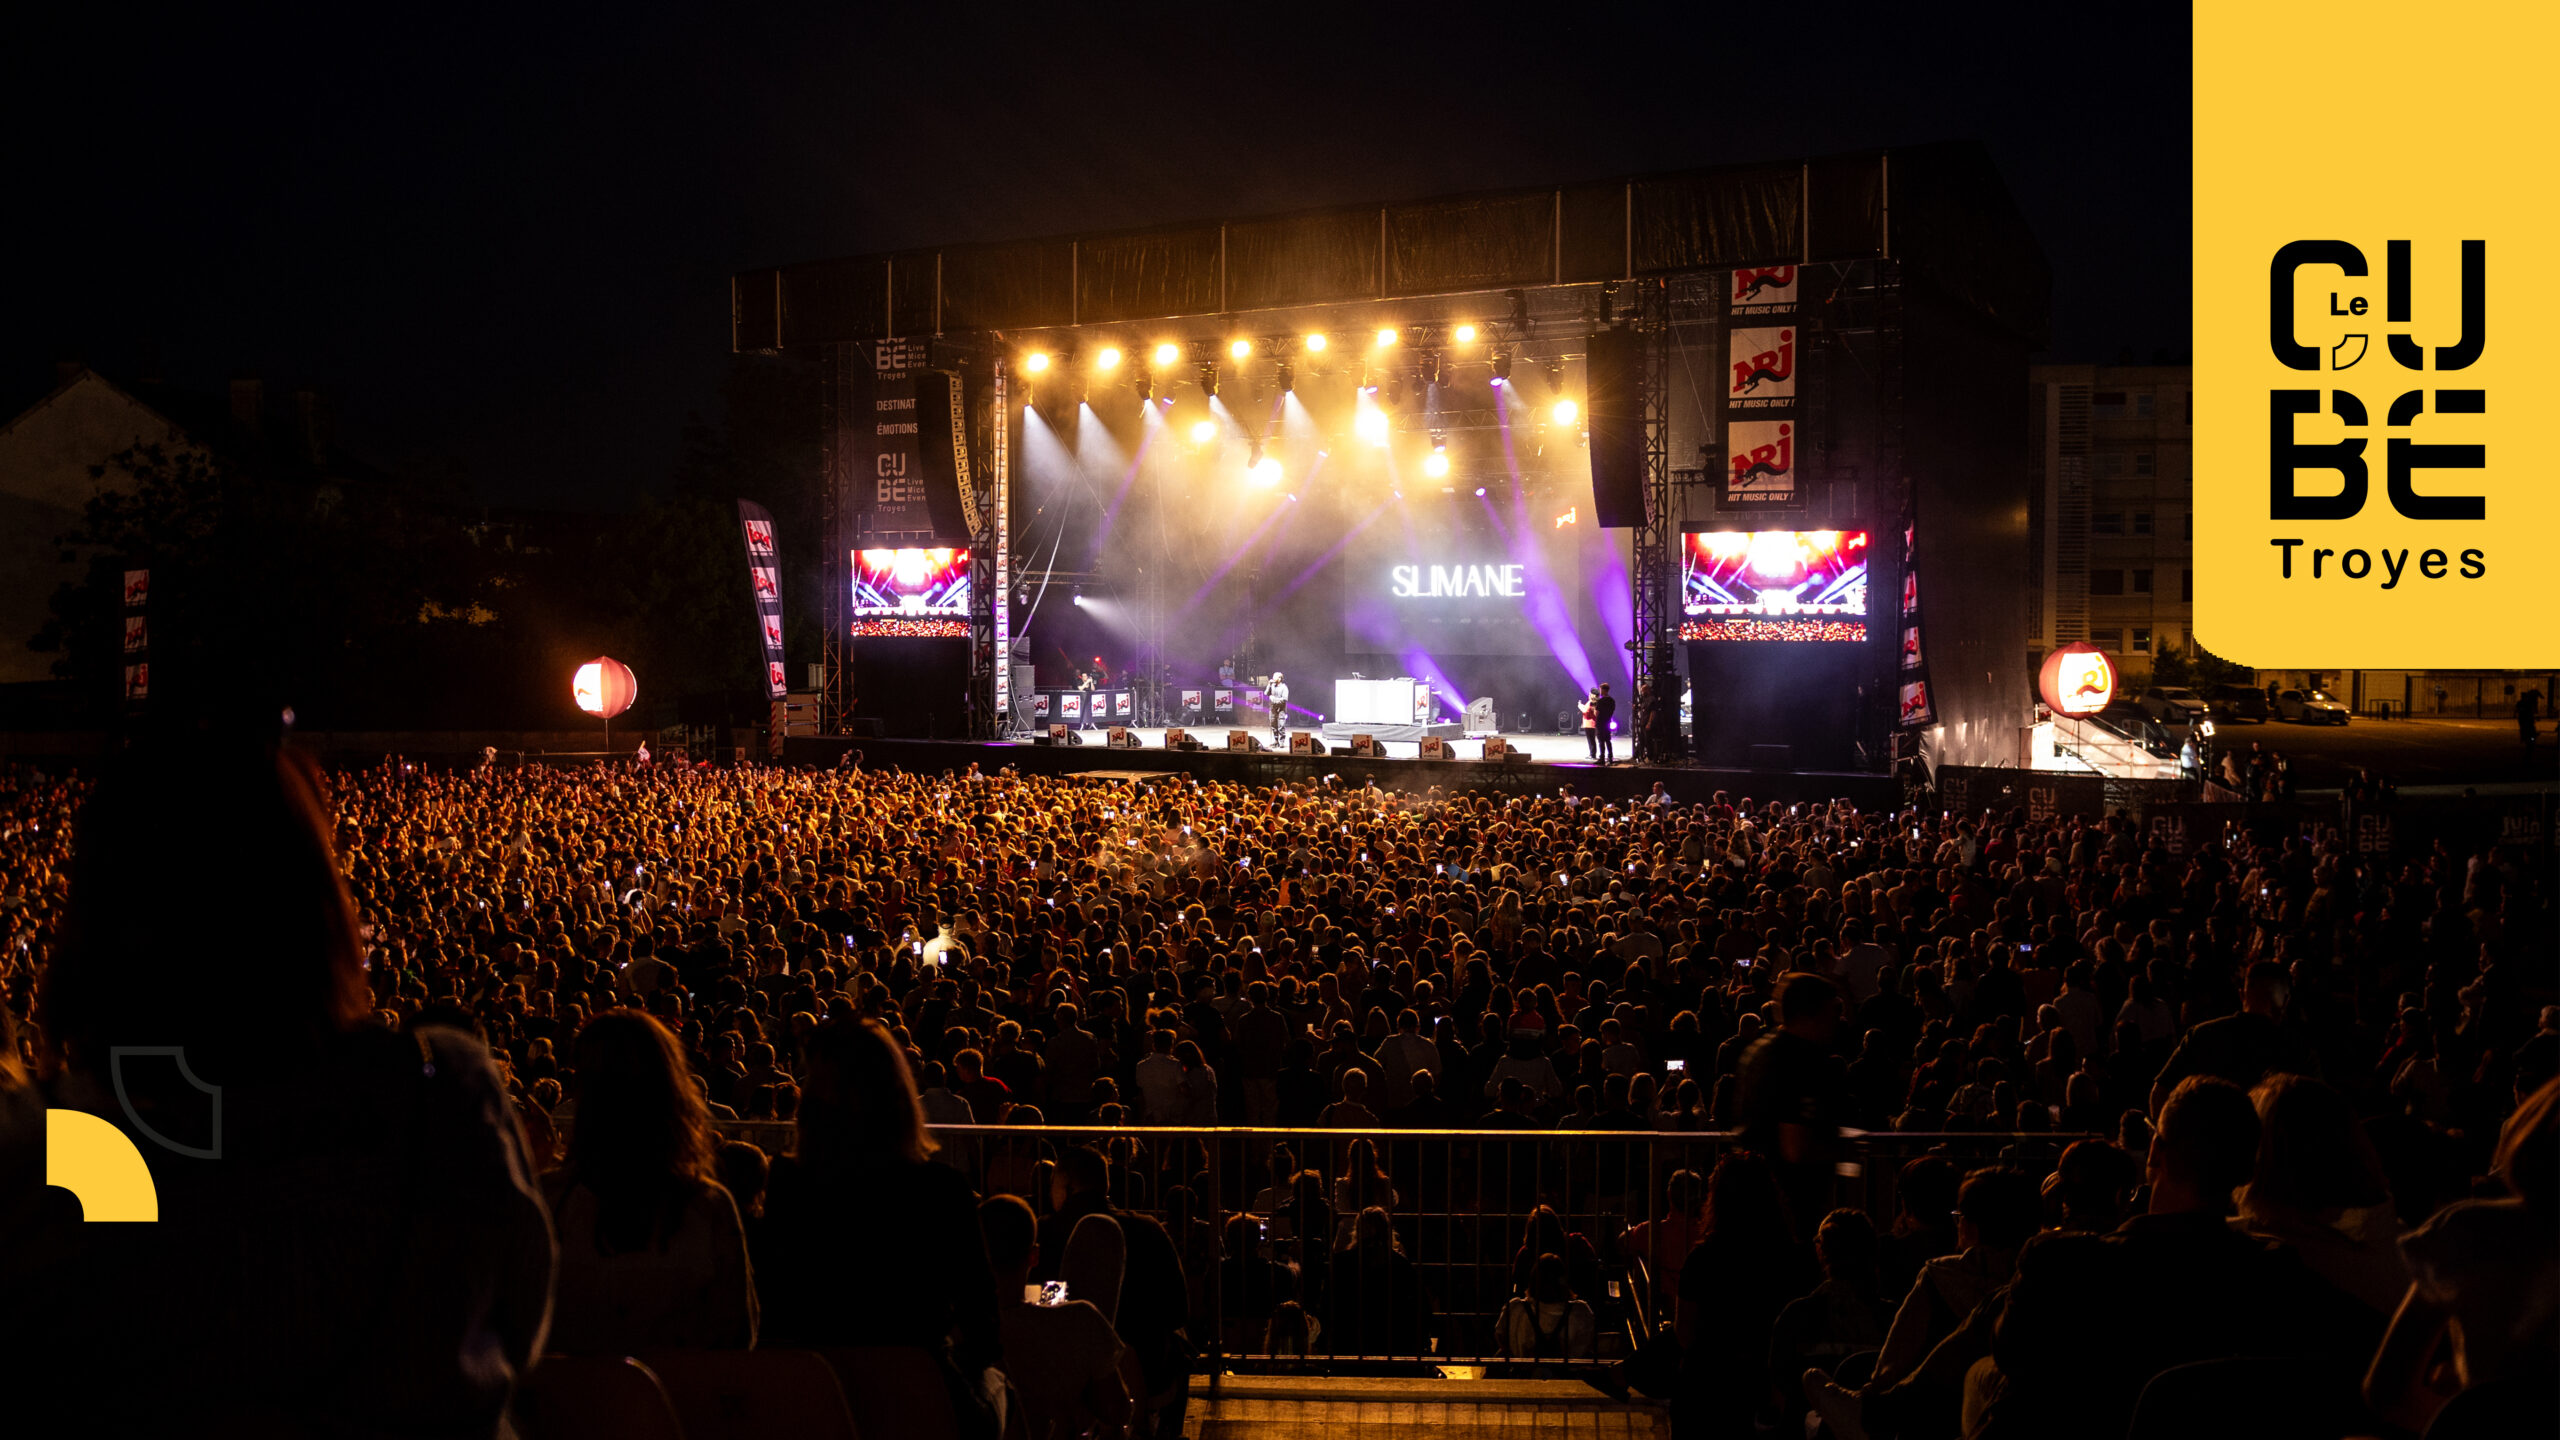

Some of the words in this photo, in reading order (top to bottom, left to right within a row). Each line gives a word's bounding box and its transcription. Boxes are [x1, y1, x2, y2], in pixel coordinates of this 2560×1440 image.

[1731, 307, 1744, 316] HIT
[1745, 306, 1770, 315] MUSIC
[1772, 305, 1791, 313] ONLY
[877, 371, 906, 380] Troyes
[876, 399, 917, 411] DESTINAT
[1729, 400, 1742, 409] HIT
[1743, 400, 1769, 408] MUSIC
[1770, 399, 1789, 407] ONLY
[876, 421, 918, 435] ÉMOTIONS
[1728, 494, 1741, 502] HIT
[1742, 493, 1768, 501] MUSIC
[1769, 492, 1789, 500] ONLY
[877, 504, 906, 514] Troyes
[1392, 564, 1526, 597] SLIMANE
